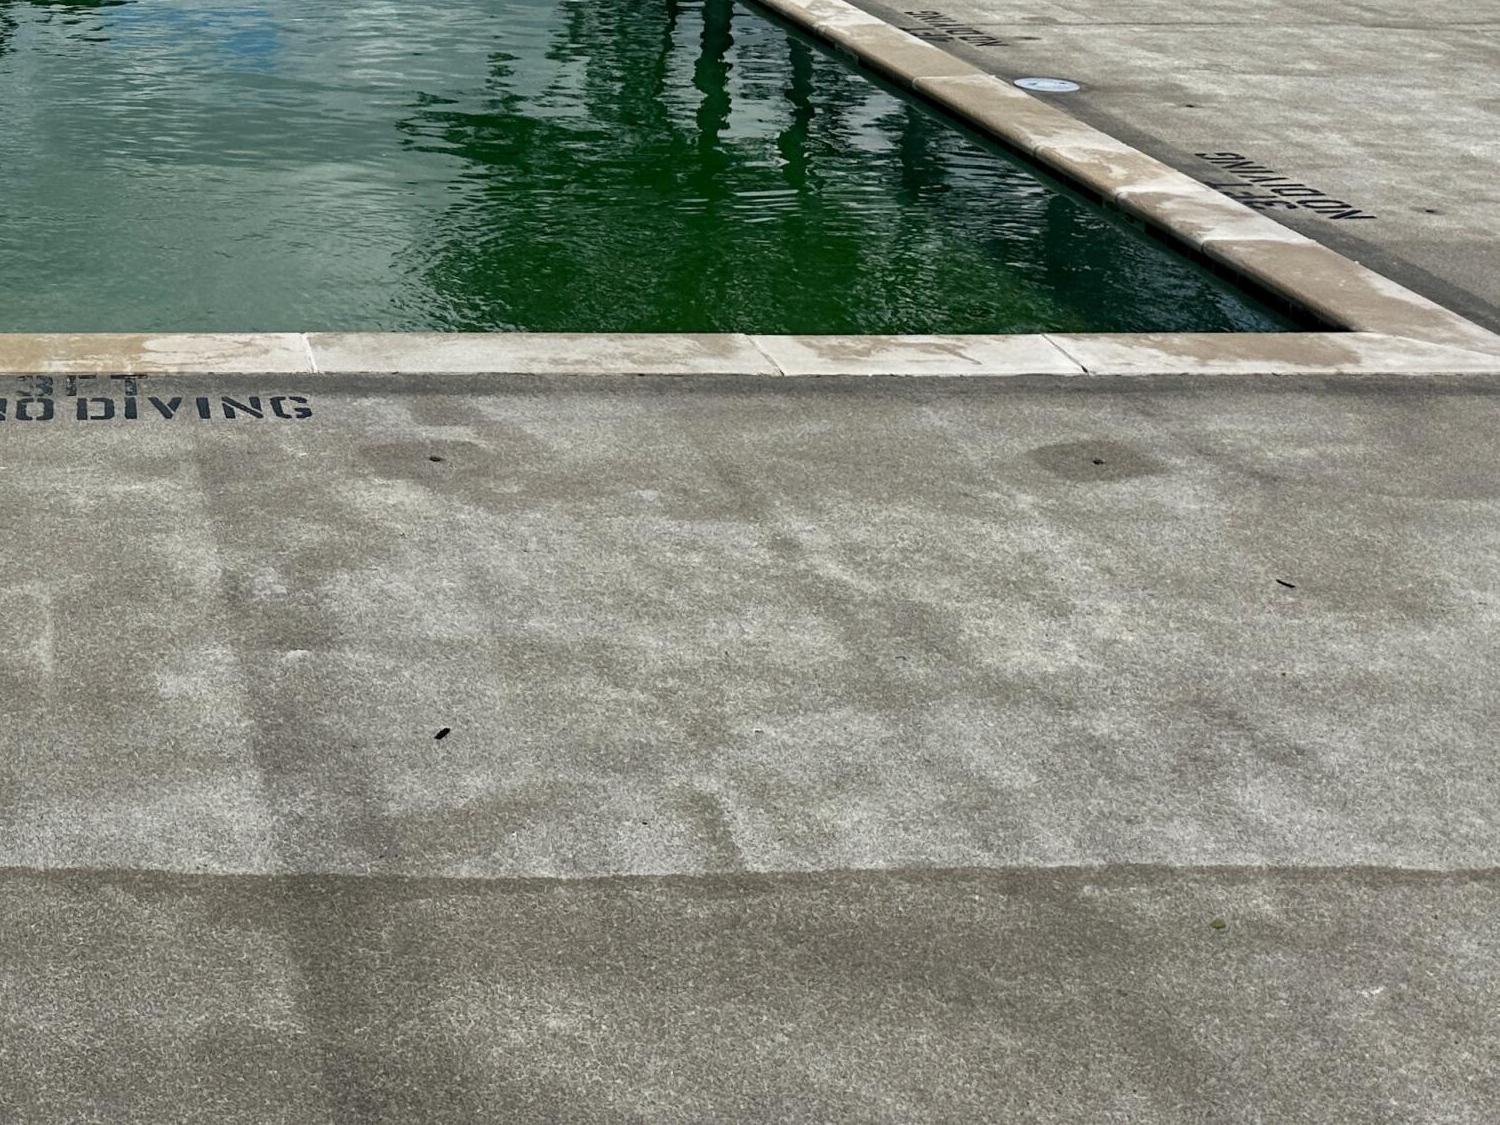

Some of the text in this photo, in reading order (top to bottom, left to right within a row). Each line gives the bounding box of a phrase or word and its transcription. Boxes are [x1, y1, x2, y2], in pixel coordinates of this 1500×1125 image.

[1194, 152, 1377, 220] NO DIVING
[76, 396, 313, 421] DIVING
